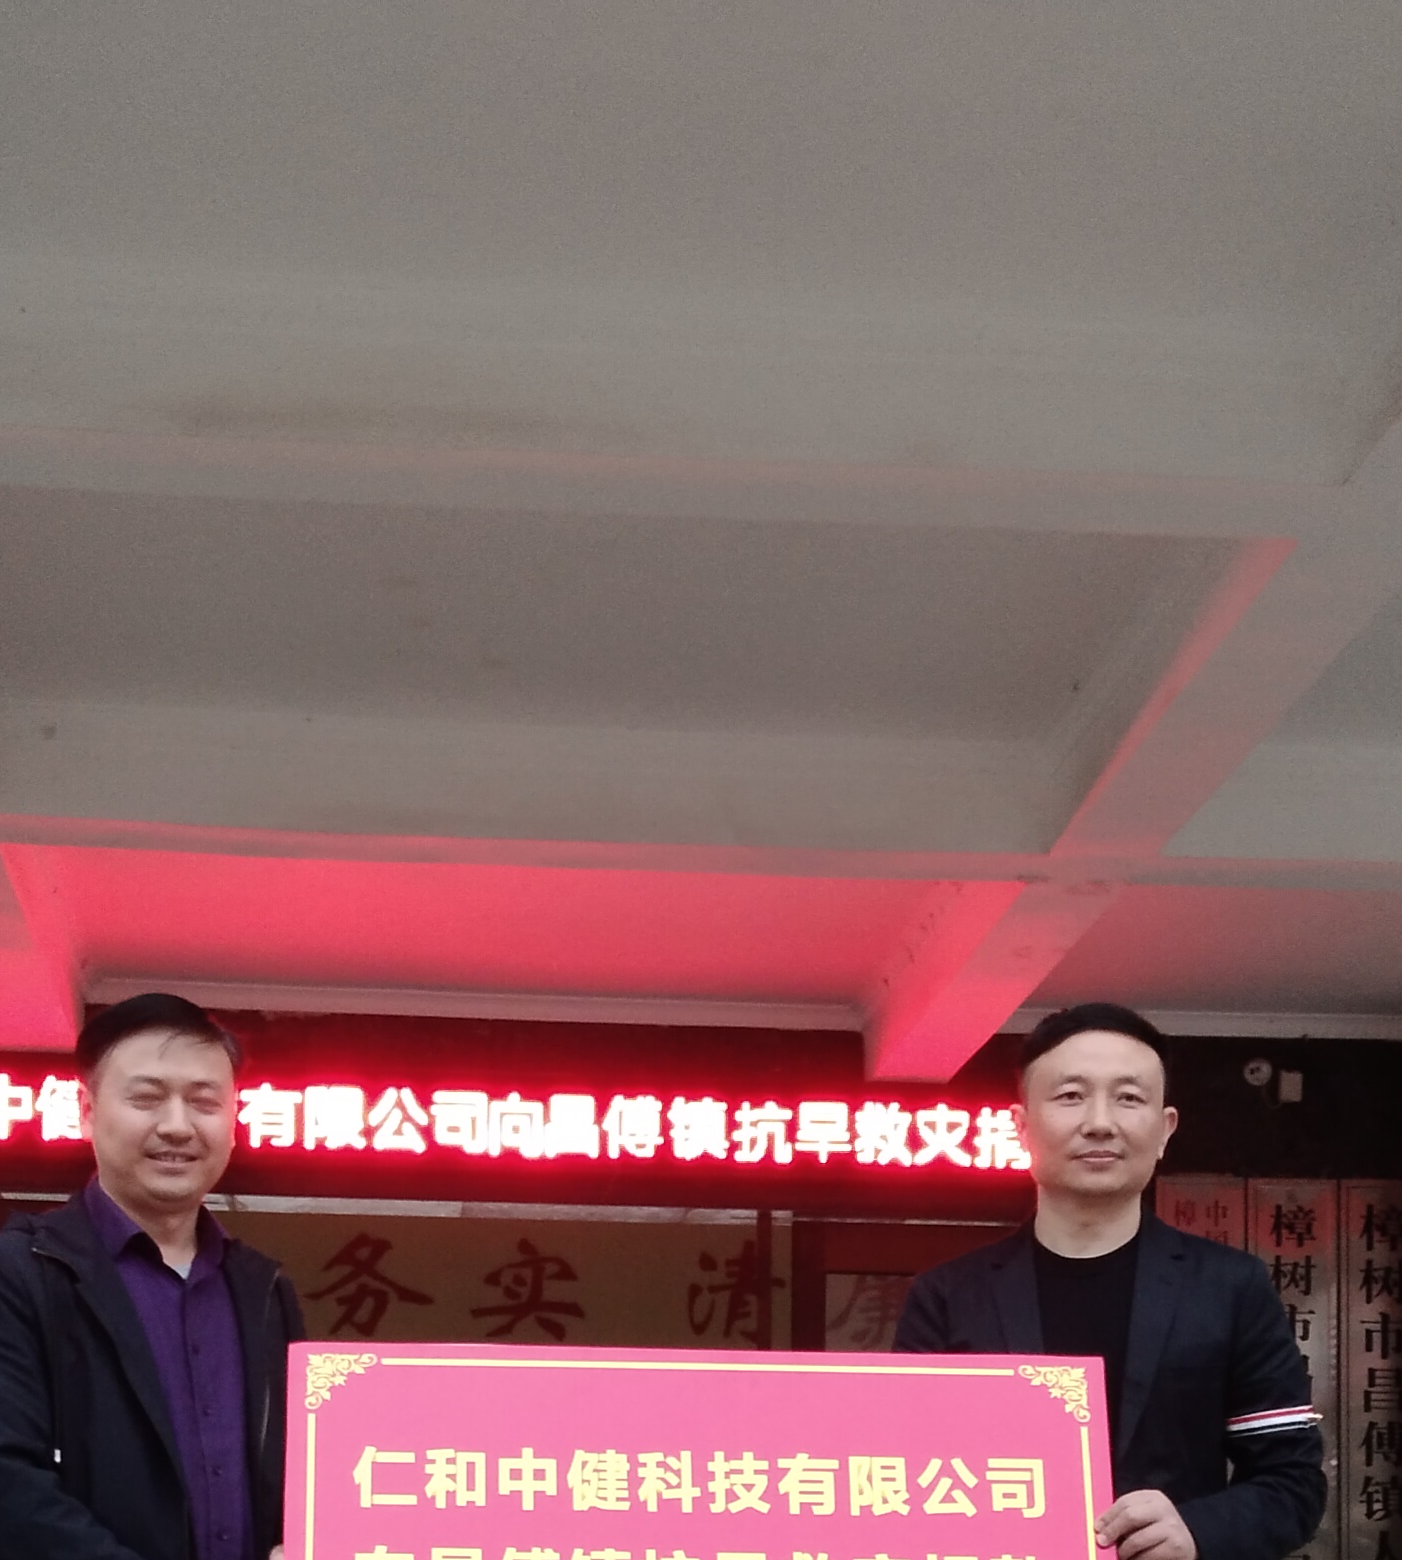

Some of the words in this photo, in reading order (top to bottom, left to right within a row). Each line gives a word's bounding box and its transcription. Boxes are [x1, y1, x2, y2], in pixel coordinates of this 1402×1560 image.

[353, 1446, 1045, 1518] 仁和中健科技有限公司
